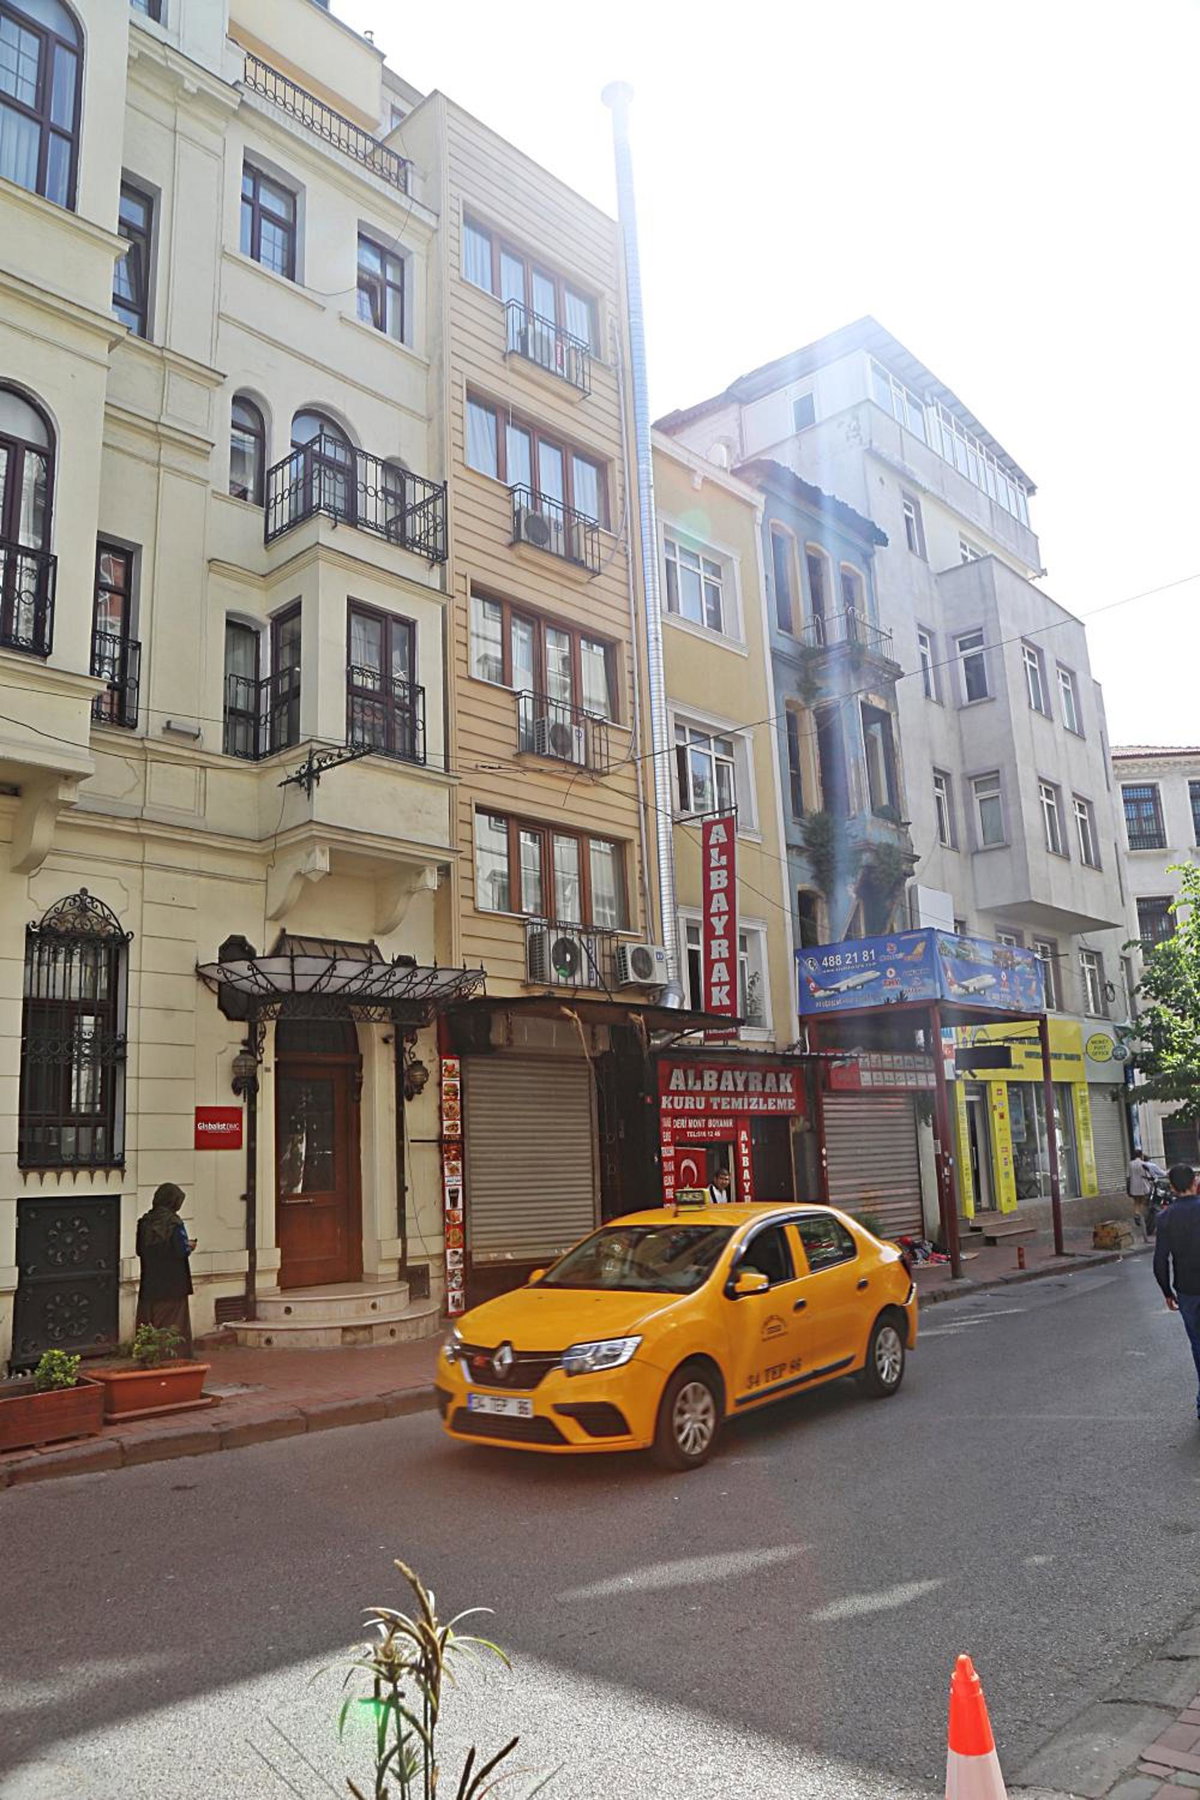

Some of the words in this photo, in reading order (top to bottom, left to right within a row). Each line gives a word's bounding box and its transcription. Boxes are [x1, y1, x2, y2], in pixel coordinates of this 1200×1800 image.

[709, 824, 731, 1007] ALBAYRAK
[822, 954, 842, 968] 488
[845, 952, 858, 965] 21
[862, 949, 876, 962] 81
[669, 1068, 793, 1093] ALBAYRAK
[661, 1095, 706, 1110] KURU
[710, 1094, 796, 1111] TEMİZLEME
